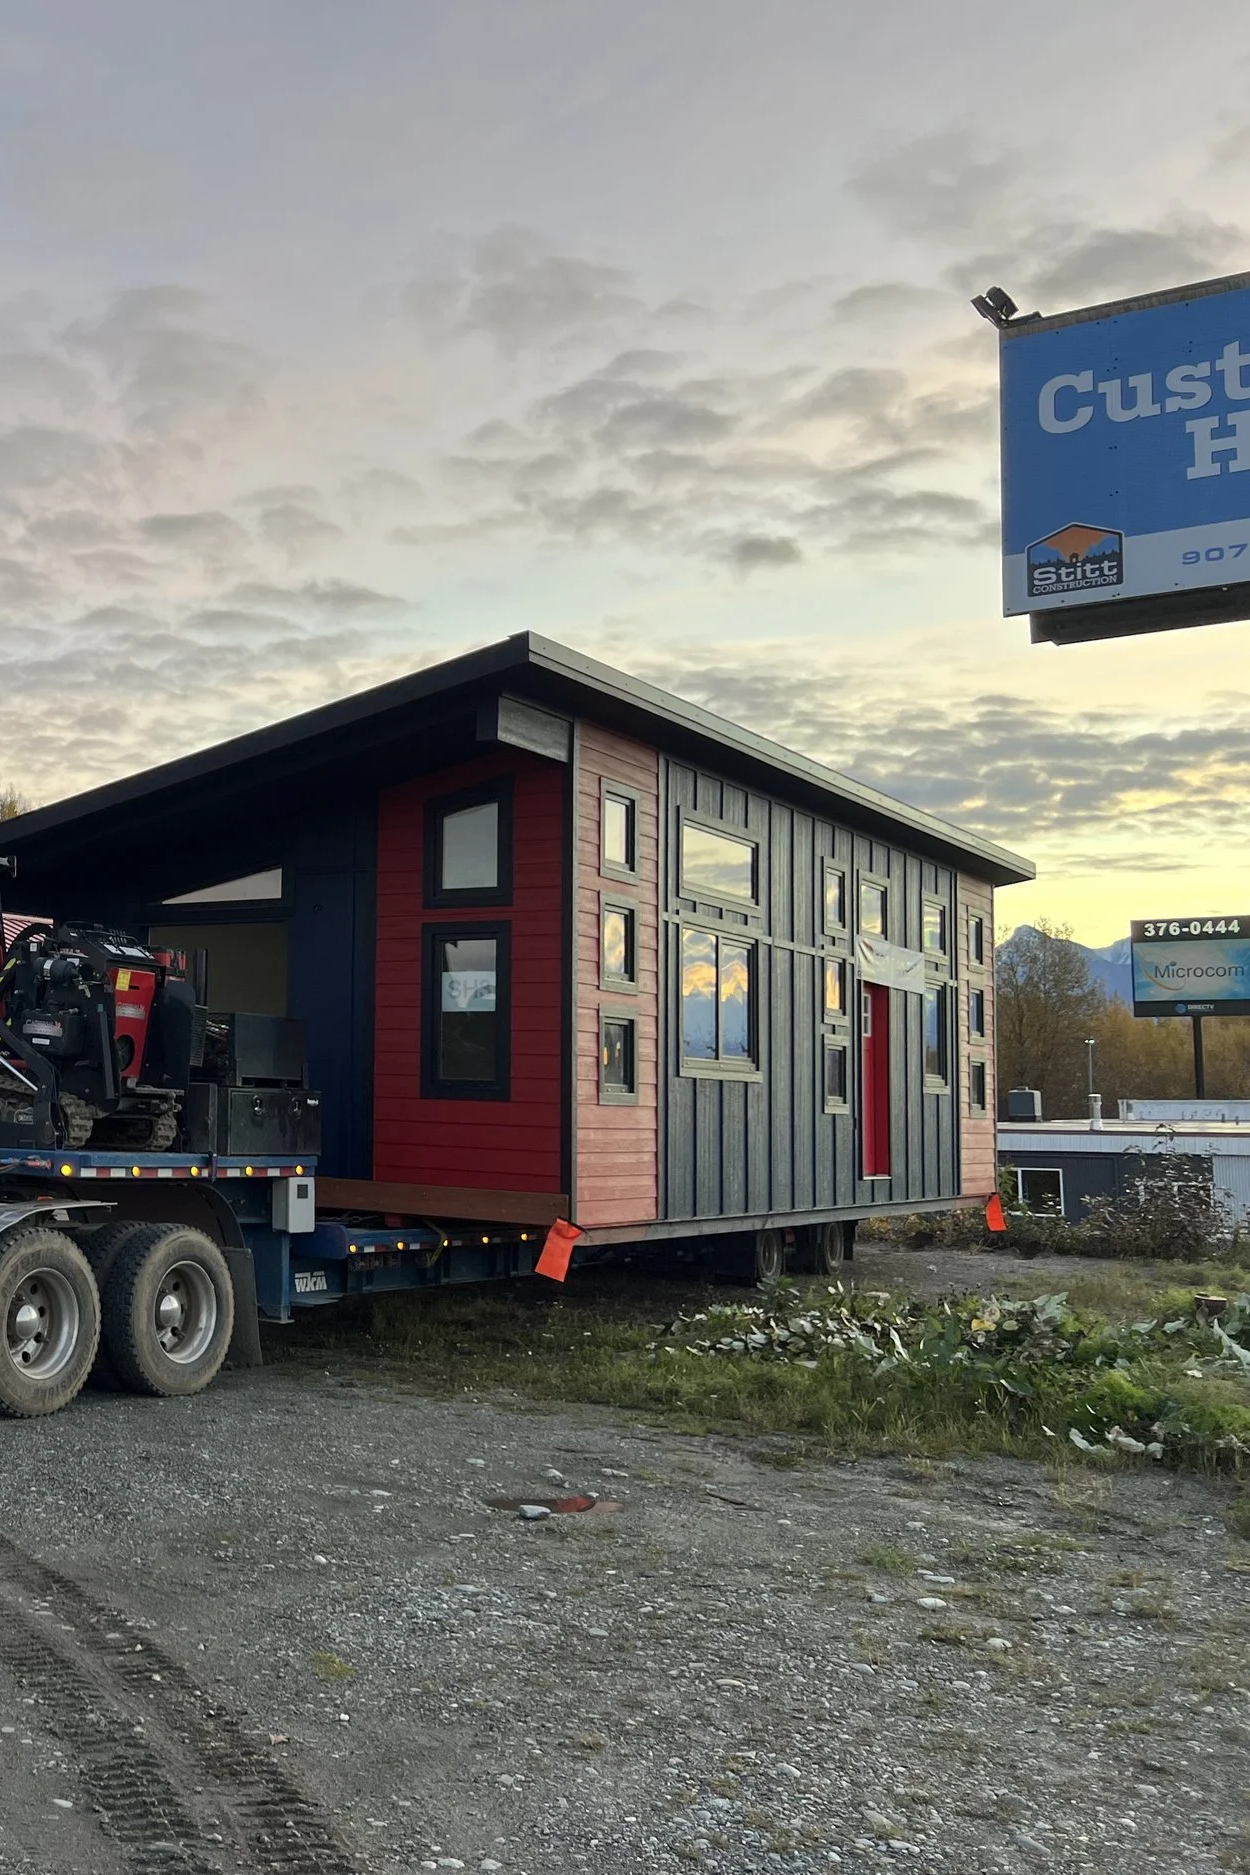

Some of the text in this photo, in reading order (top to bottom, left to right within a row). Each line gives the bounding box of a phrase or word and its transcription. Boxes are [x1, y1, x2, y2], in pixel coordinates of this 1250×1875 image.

[1181, 543, 1248, 565] 907
[1033, 560, 1118, 586] Stitt
[1032, 575, 1118, 594] CONSTRUCTION
[1144, 919, 1241, 937] 376-0444
[1154, 960, 1245, 979] Microcom
